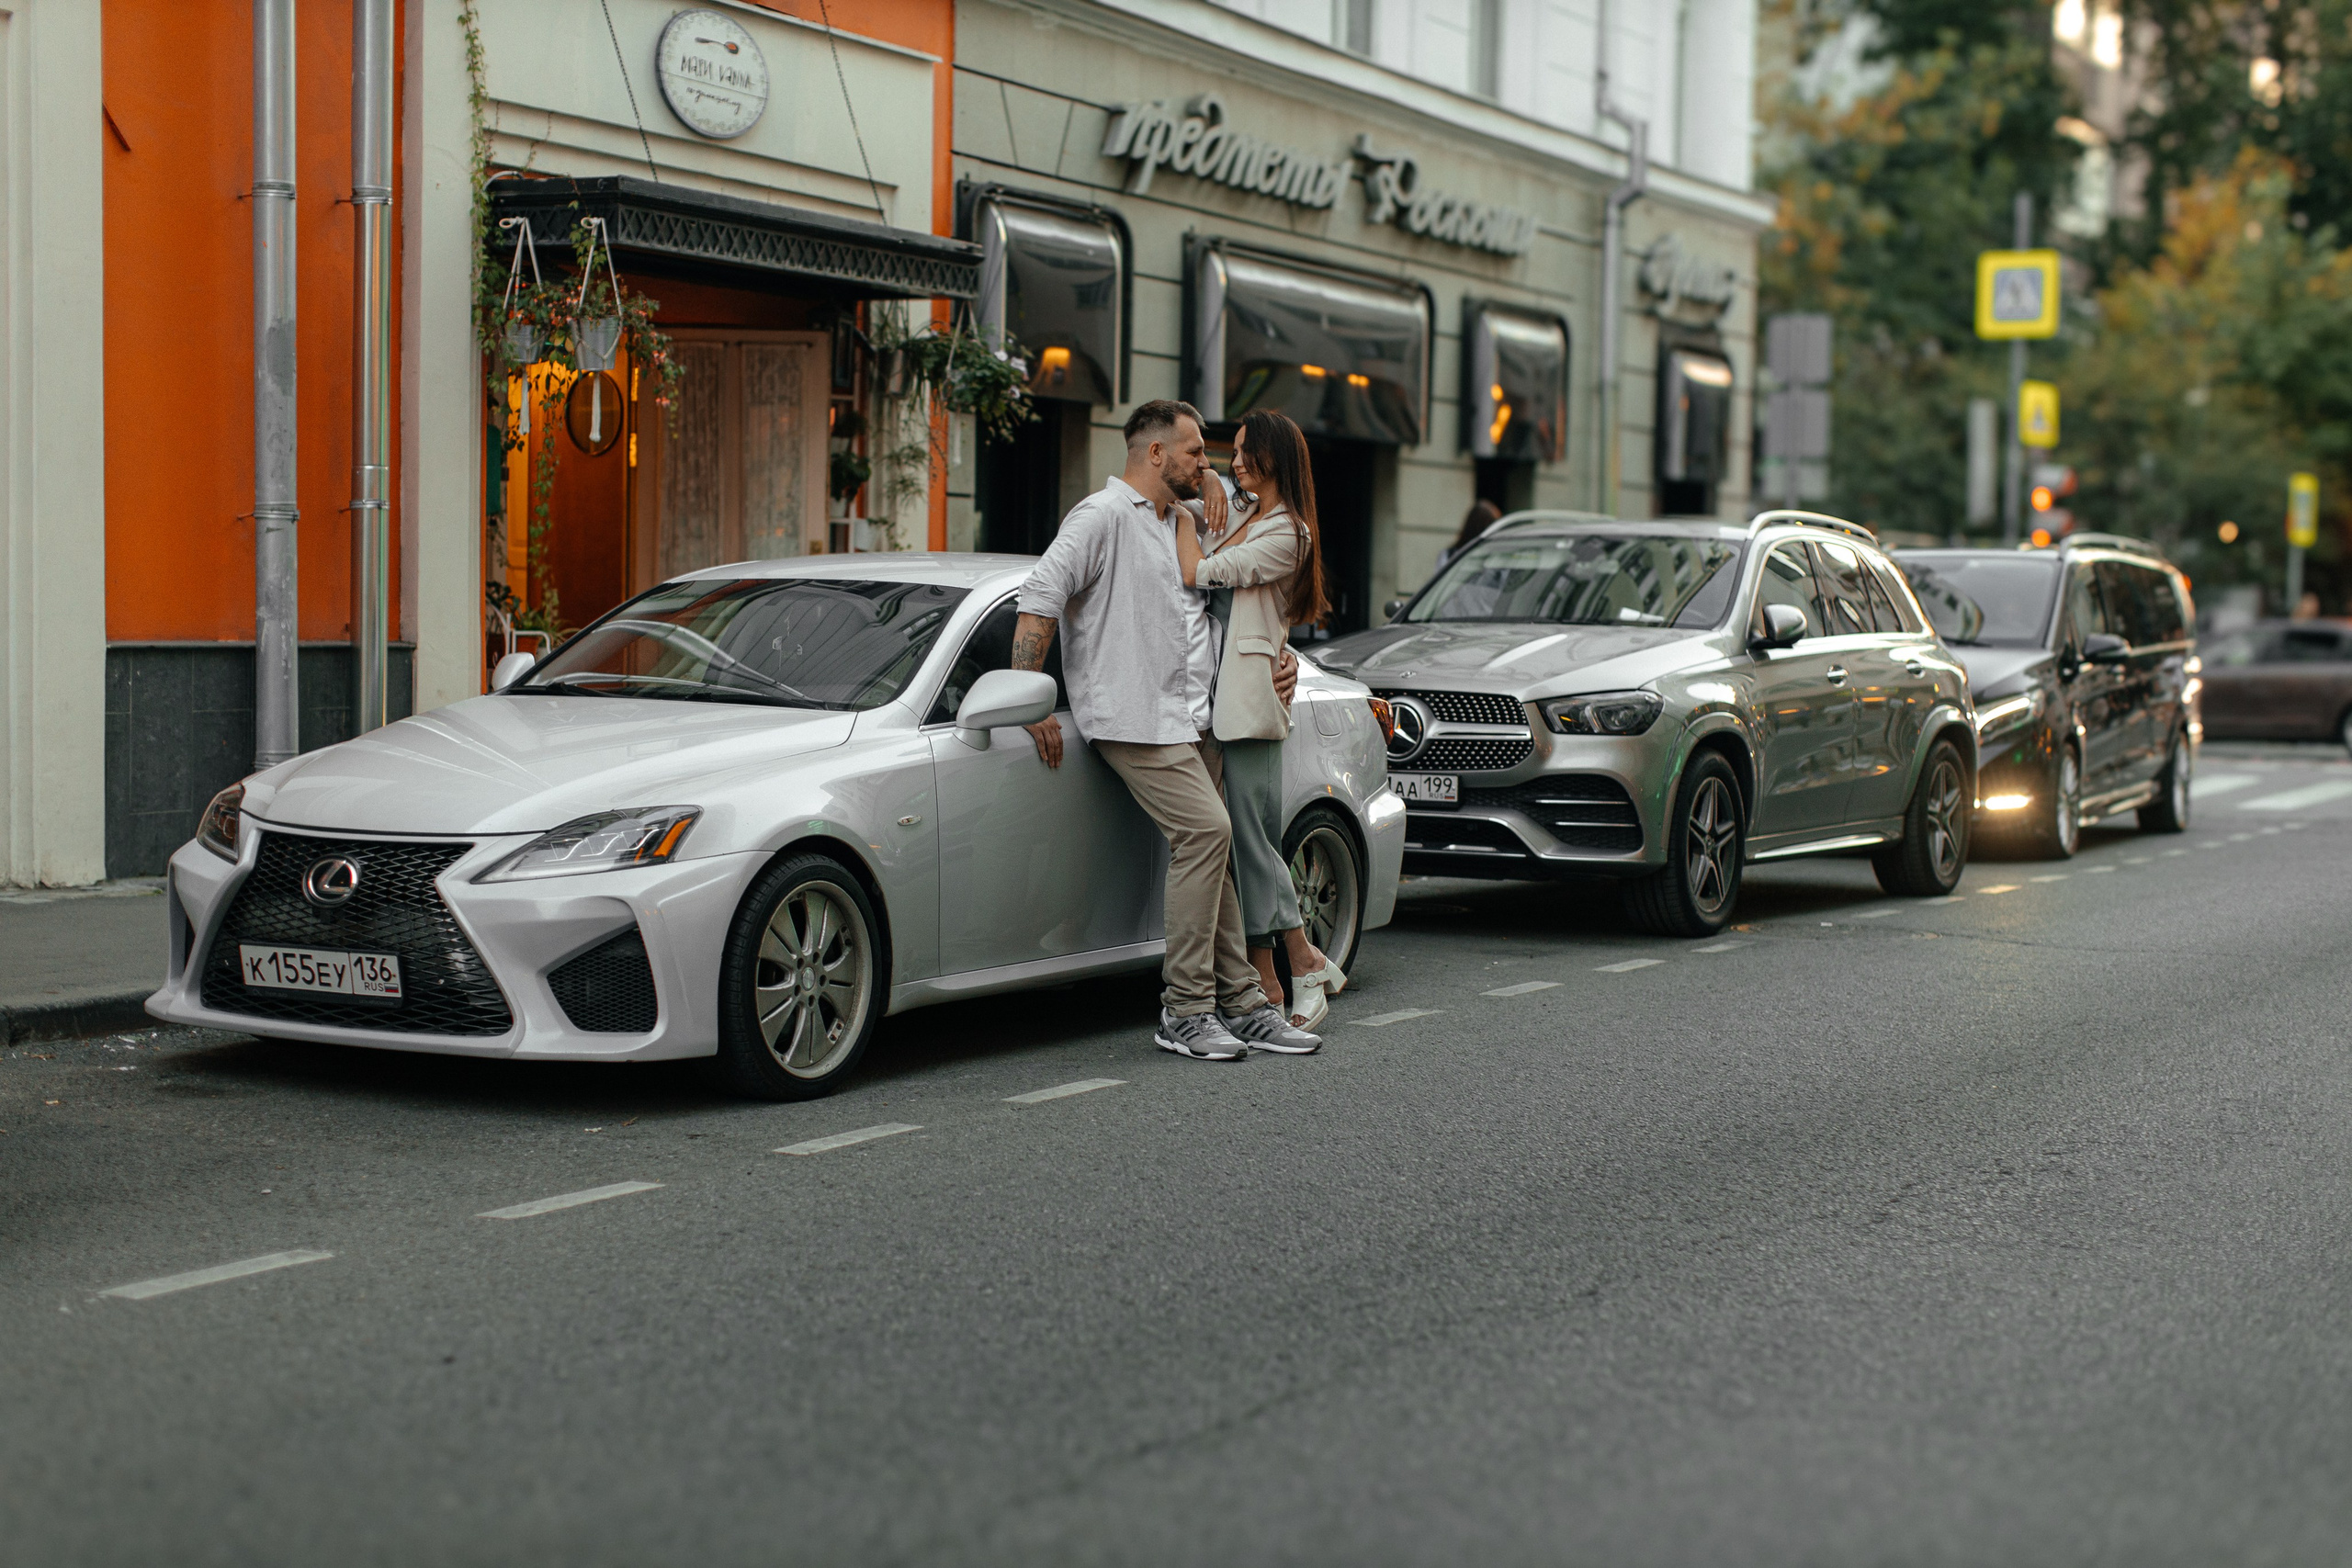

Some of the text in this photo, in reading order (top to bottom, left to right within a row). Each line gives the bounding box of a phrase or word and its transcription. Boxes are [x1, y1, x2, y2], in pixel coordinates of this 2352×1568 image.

[1424, 776, 1453, 793] 199
[353, 956, 392, 982] 136
[364, 982, 384, 992] RUS
